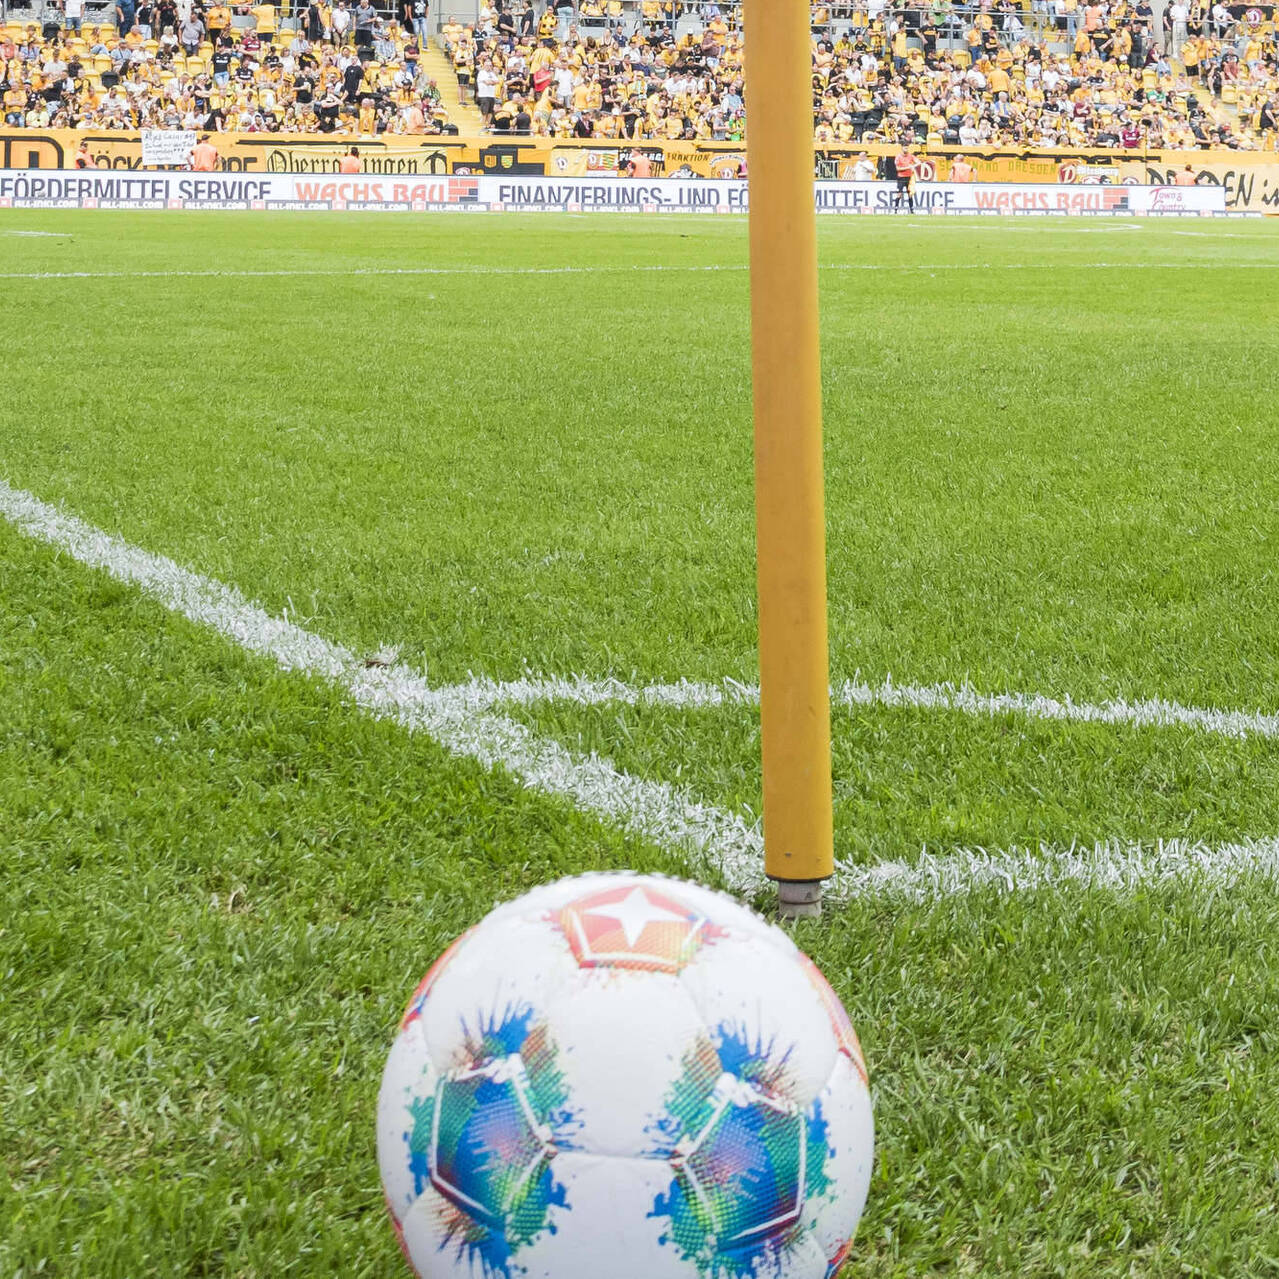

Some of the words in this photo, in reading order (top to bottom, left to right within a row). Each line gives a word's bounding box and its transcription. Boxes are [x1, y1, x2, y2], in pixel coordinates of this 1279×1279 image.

[295, 182, 389, 203] WACHS
[394, 183, 445, 203] BAU
[499, 185, 671, 206] FINANZIERUNGS-
[678, 186, 719, 206] UND
[974, 191, 1051, 210] WACHS
[1056, 192, 1098, 210] BAU
